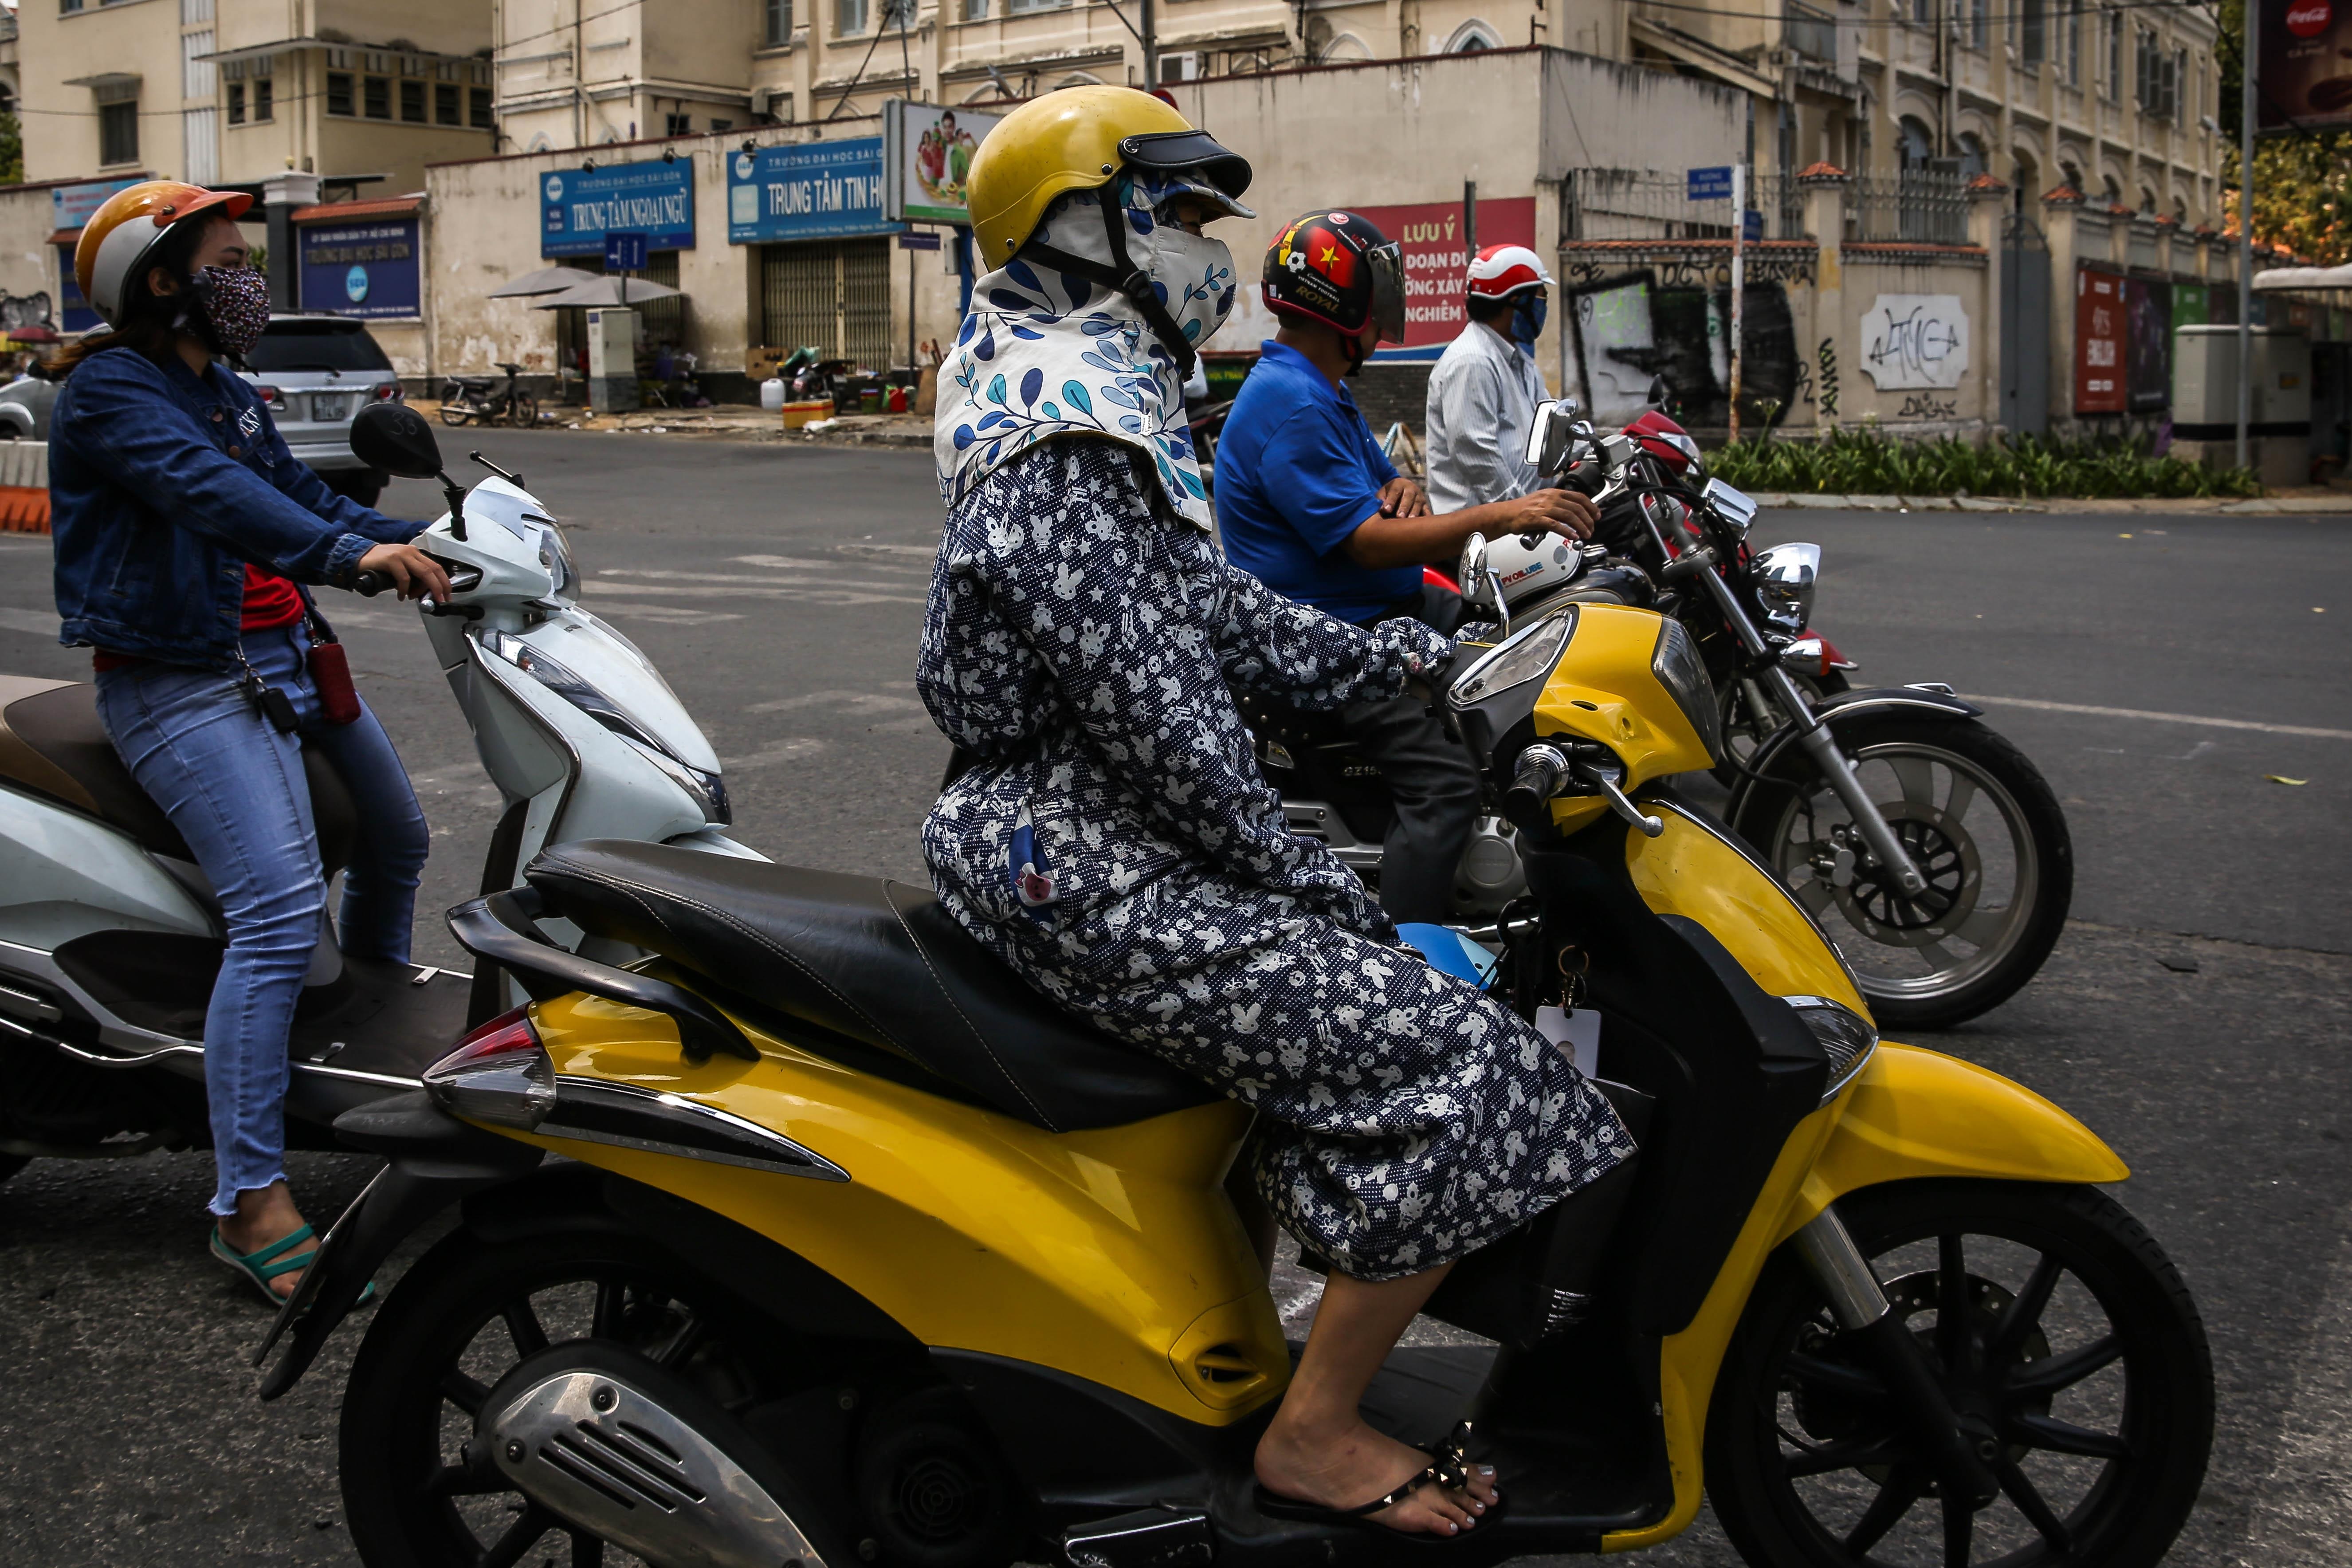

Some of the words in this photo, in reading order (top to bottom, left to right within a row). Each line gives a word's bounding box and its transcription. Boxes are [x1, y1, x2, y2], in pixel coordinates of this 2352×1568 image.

[768, 155, 809, 167] TRƯỜNG
[832, 153, 854, 163] HỌC
[768, 180, 811, 215] TRUNG
[814, 170, 842, 212] TÂM
[845, 176, 866, 210] TIN
[573, 201, 606, 232] TRUNG
[607, 192, 630, 229] TÂM
[1403, 221, 1440, 243] LƯU
[1444, 213, 1455, 241] Ý
[1405, 252, 1448, 274] ĐOẠN
[1298, 275, 1317, 289] VIETNAM
[1318, 287, 1340, 303] FOOTBALL
[1437, 272, 1463, 295] XẢY
[1296, 285, 1339, 314] ROYAL
[1405, 299, 1461, 322] NGHIÊM
[1501, 574, 1512, 586] PV
[1344, 766, 1382, 776] GZ15
